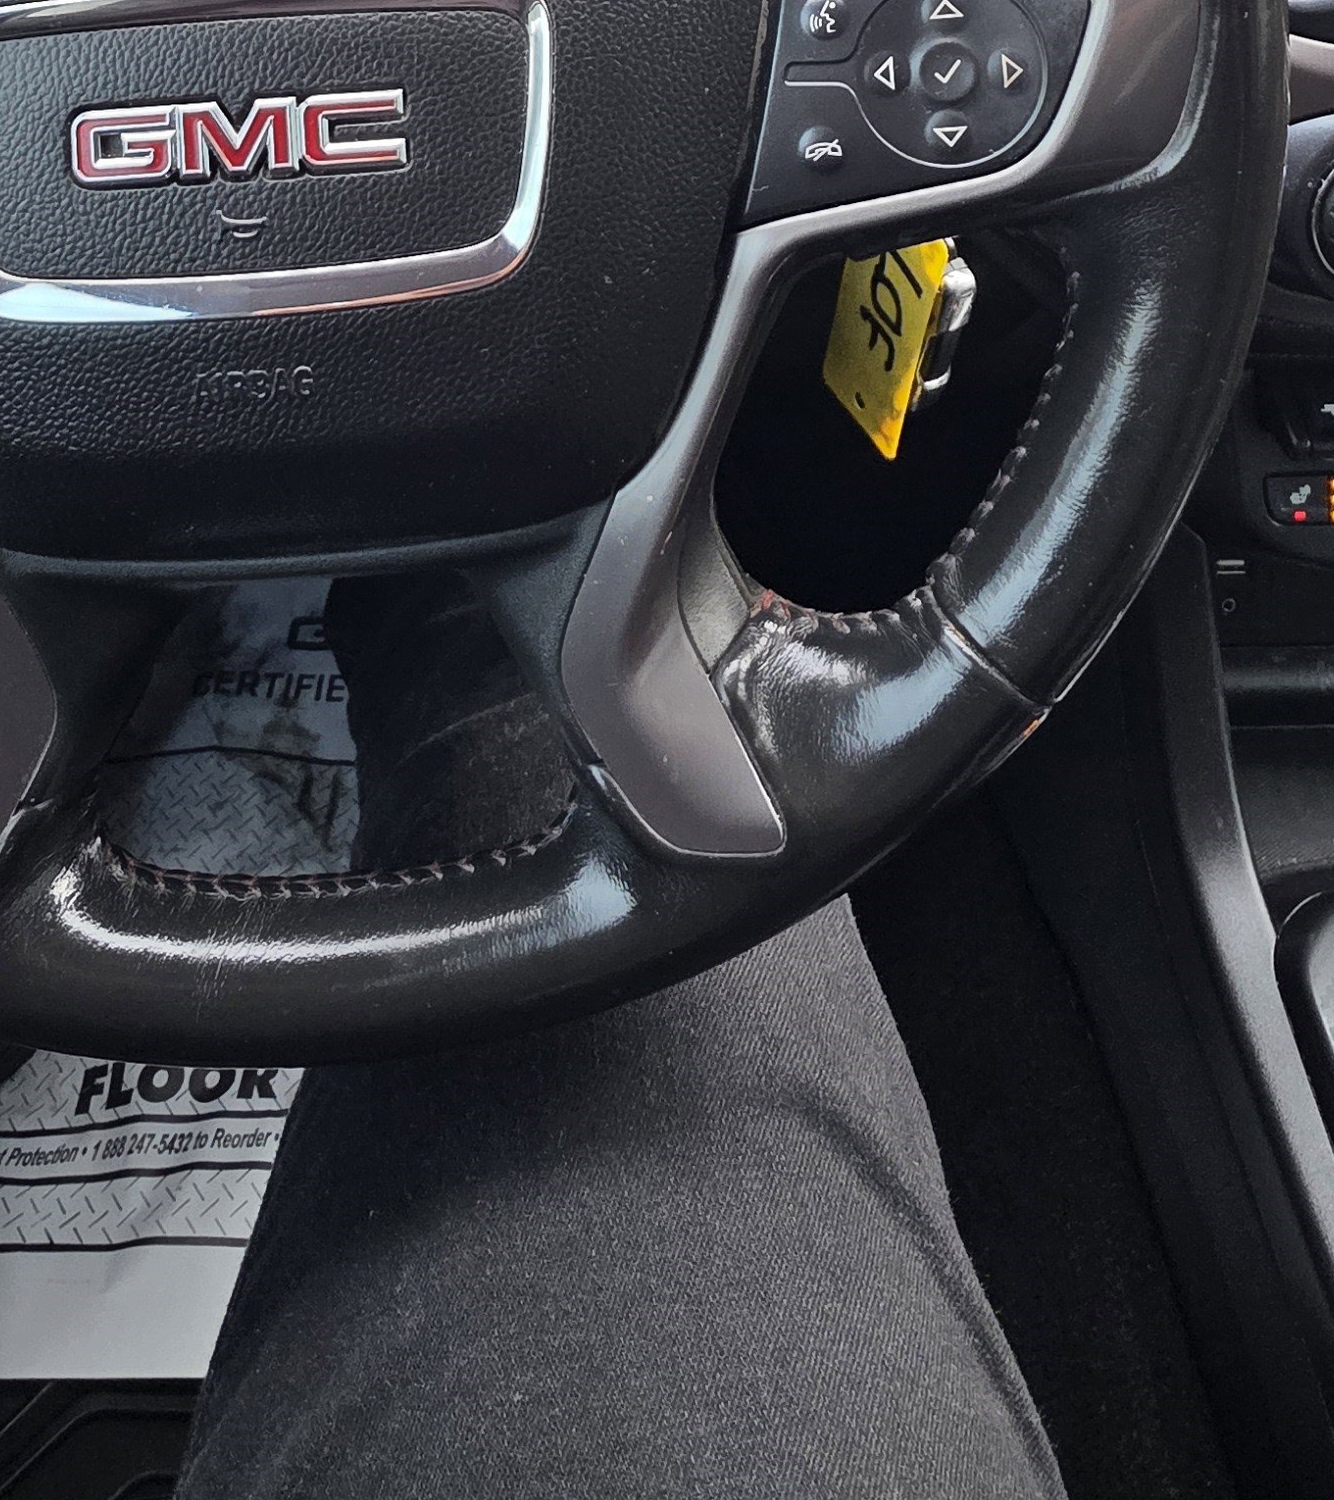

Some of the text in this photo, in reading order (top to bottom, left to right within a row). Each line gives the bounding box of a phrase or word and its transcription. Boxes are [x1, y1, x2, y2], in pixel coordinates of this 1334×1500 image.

[71, 88, 407, 190] GMC
[74, 1062, 279, 1116] FLOOR
[4, 1143, 79, 1168] Protection
[102, 1135, 126, 1161] 888
[127, 1131, 193, 1156] 247-5432
[195, 1131, 209, 1150] to
[210, 1127, 272, 1150] Reorder
